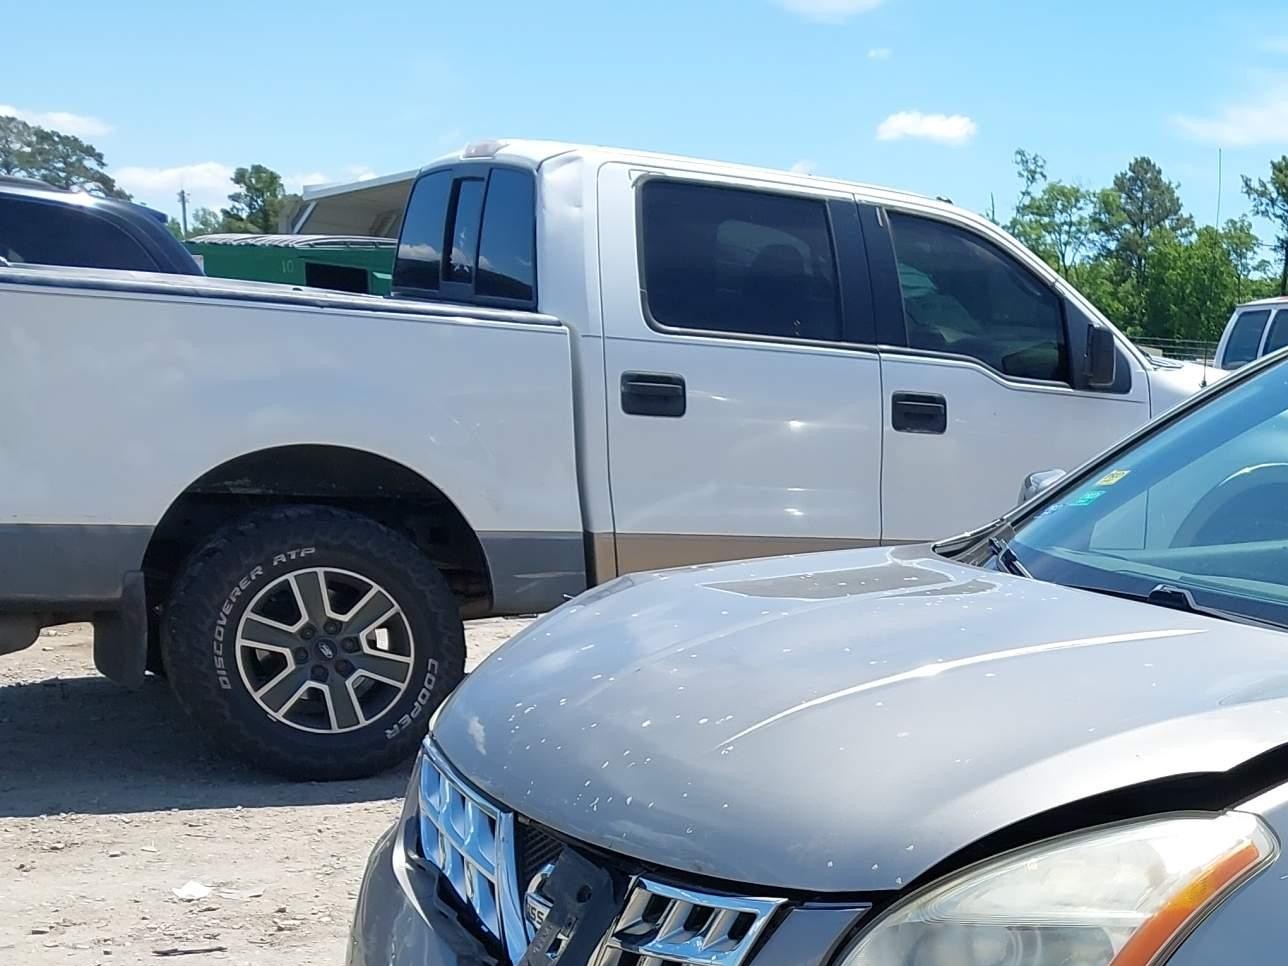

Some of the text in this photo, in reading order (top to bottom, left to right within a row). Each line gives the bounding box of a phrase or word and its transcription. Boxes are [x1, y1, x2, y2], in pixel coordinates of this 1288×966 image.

[211, 546, 317, 690] DISCOVERER ATP
[384, 658, 441, 741] COOPER
